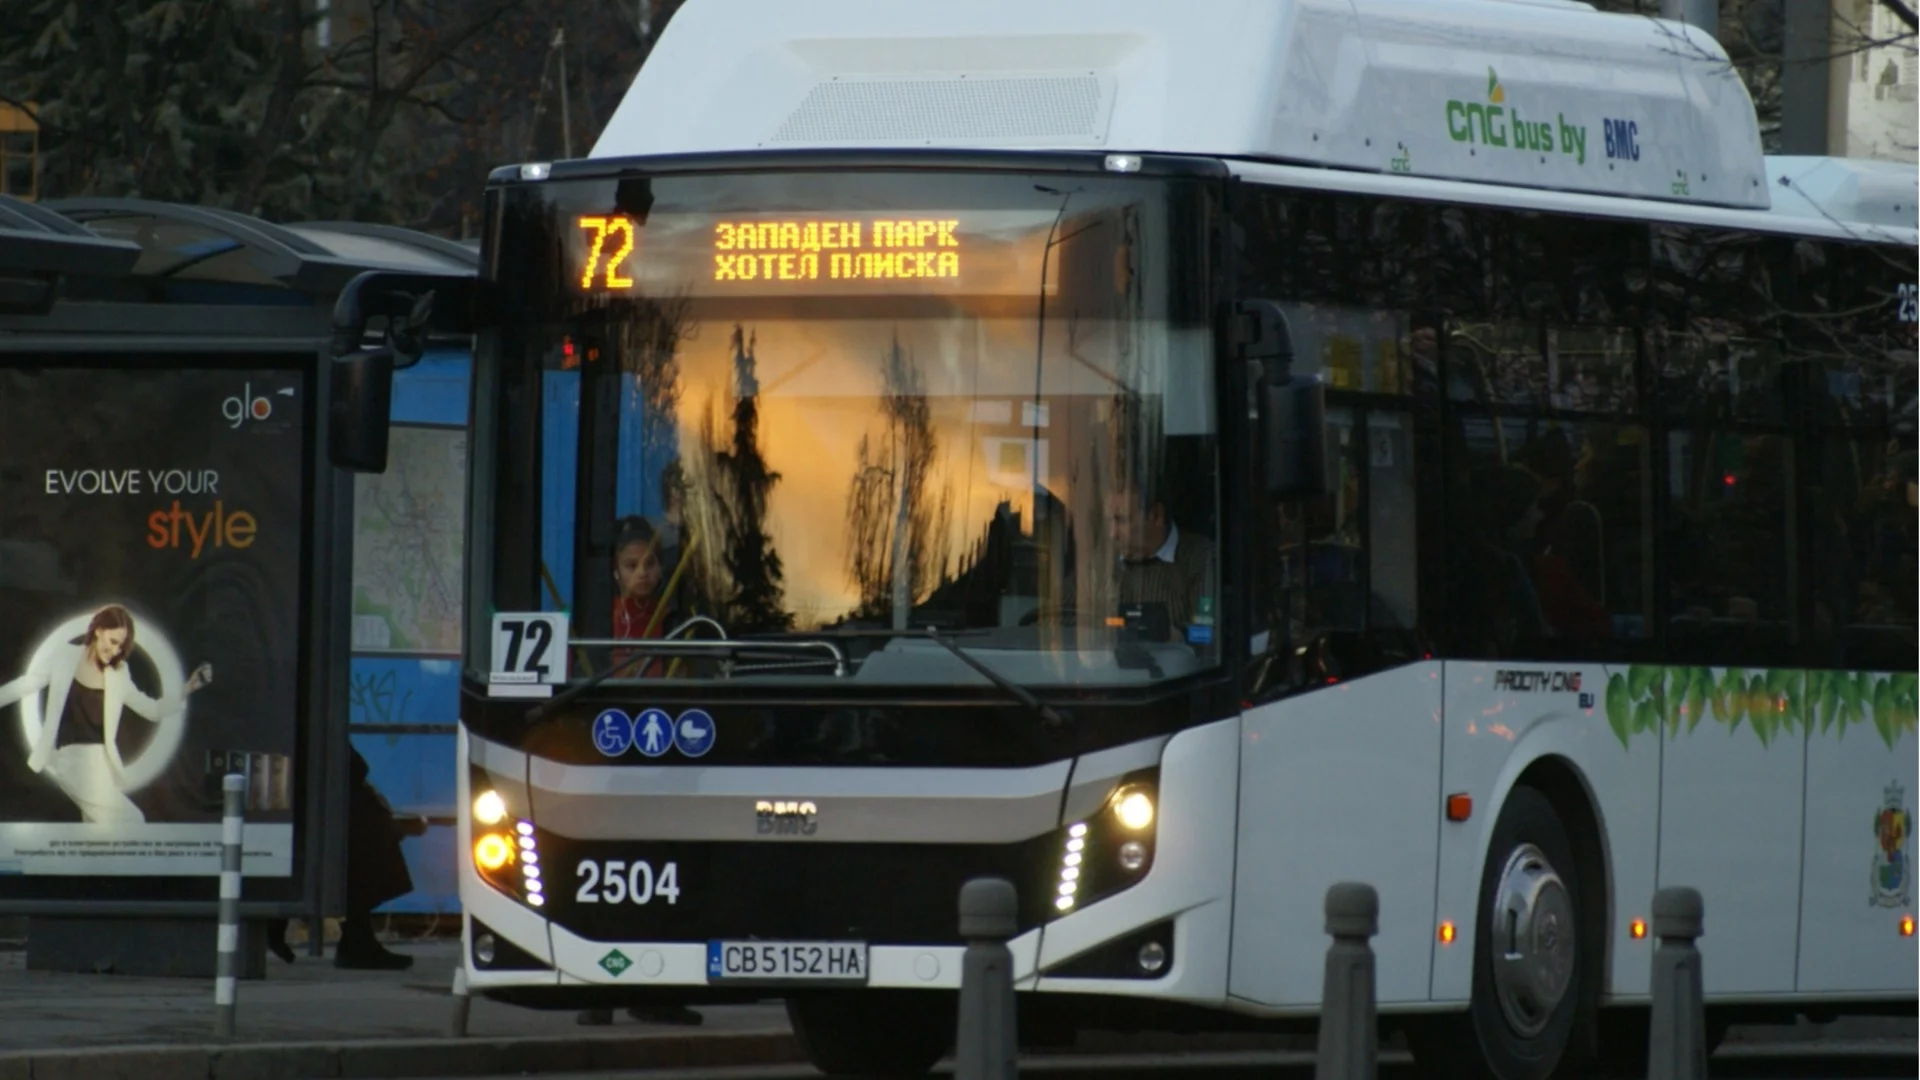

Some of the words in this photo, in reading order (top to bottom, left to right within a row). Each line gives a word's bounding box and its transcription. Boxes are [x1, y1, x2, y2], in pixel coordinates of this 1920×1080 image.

[1511, 109, 1554, 152] bus
[1558, 113, 1587, 166] by
[1603, 118, 1640, 161] BMC
[579, 217, 635, 289] 72
[714, 221, 862, 252] ЗАПАДЕН
[872, 219, 960, 248] ПАРК
[714, 253, 819, 282] ХОТЕЛ
[829, 250, 960, 280] ПЛИСКА
[222, 381, 272, 429] glo
[45, 469, 140, 494] EVOLVE
[147, 469, 219, 494] YOUR
[146, 500, 258, 559] style
[500, 619, 553, 674] 72
[755, 800, 818, 835] BMC
[576, 860, 680, 905] 2504
